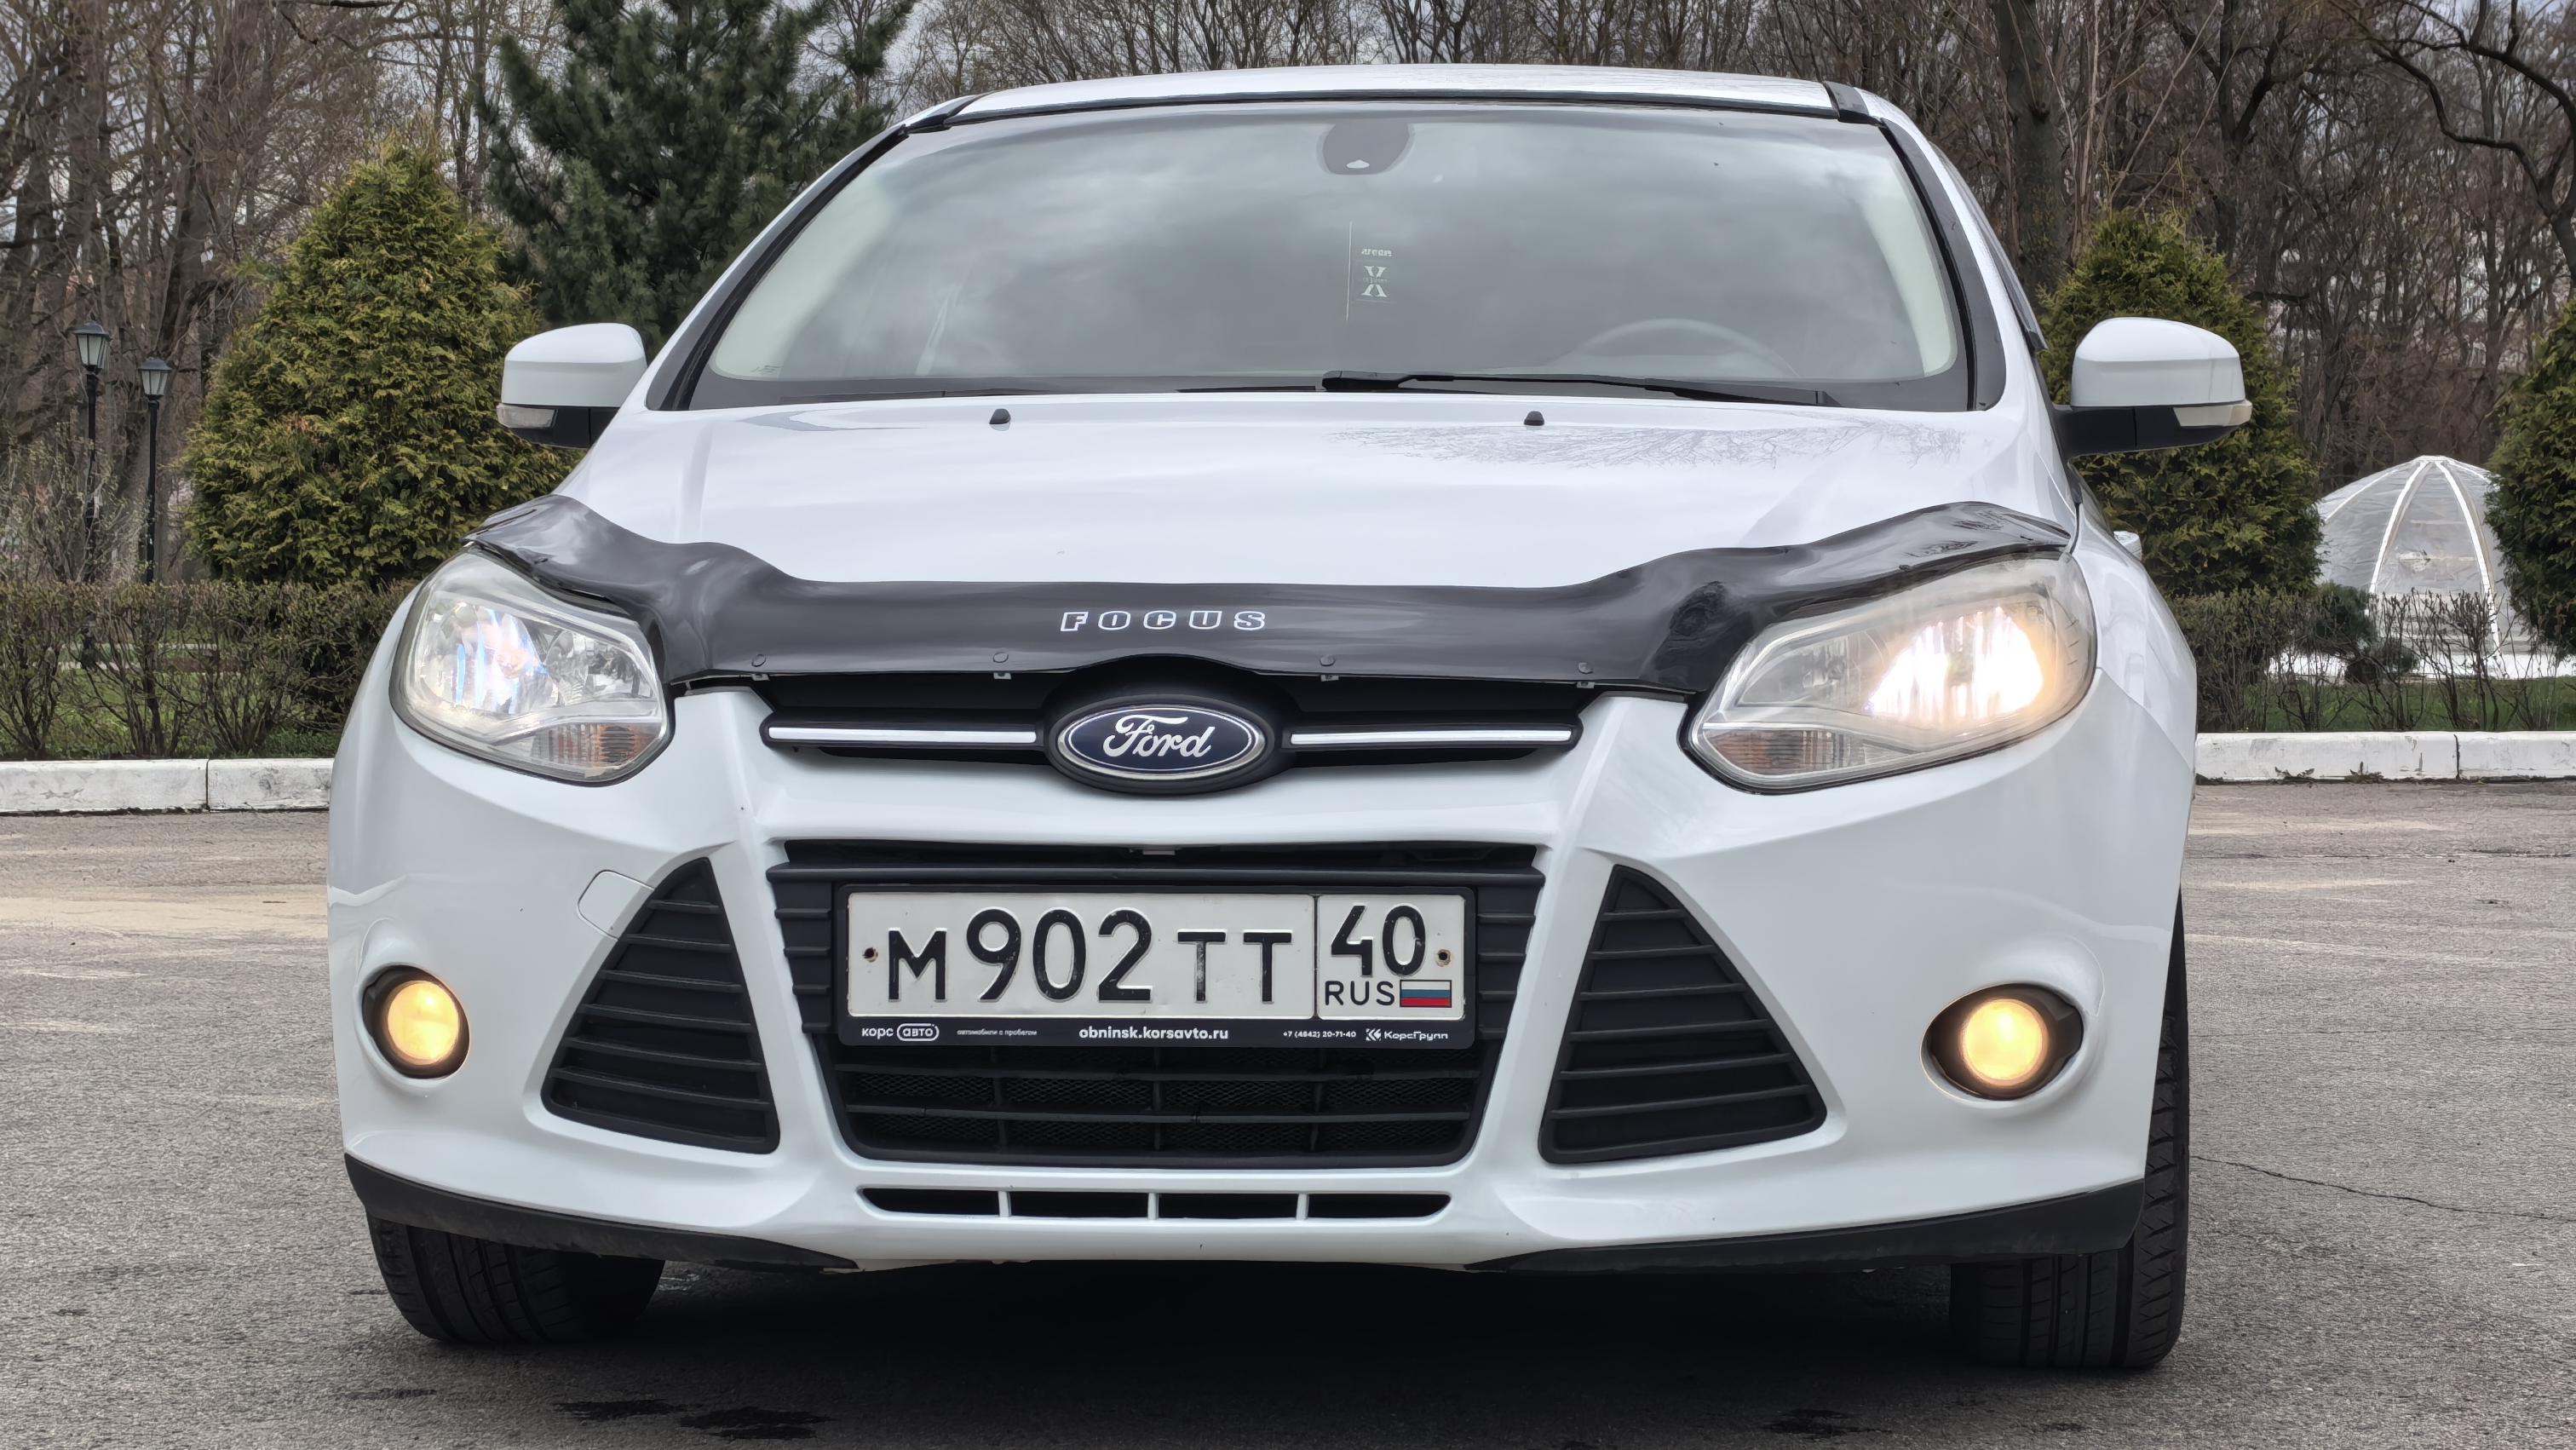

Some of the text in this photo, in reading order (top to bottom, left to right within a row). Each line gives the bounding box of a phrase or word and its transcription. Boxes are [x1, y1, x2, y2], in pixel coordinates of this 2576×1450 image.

[1060, 610, 1266, 632] FOCUS
[1102, 714, 1216, 757] Ford
[1331, 903, 1426, 977] 40
[1324, 981, 1395, 1005] RUS
[861, 1027, 934, 1039] корс авто
[1078, 1026, 1228, 1039] obninsk.korsavto.ru
[1384, 1031, 1448, 1041] КорсГрупп
